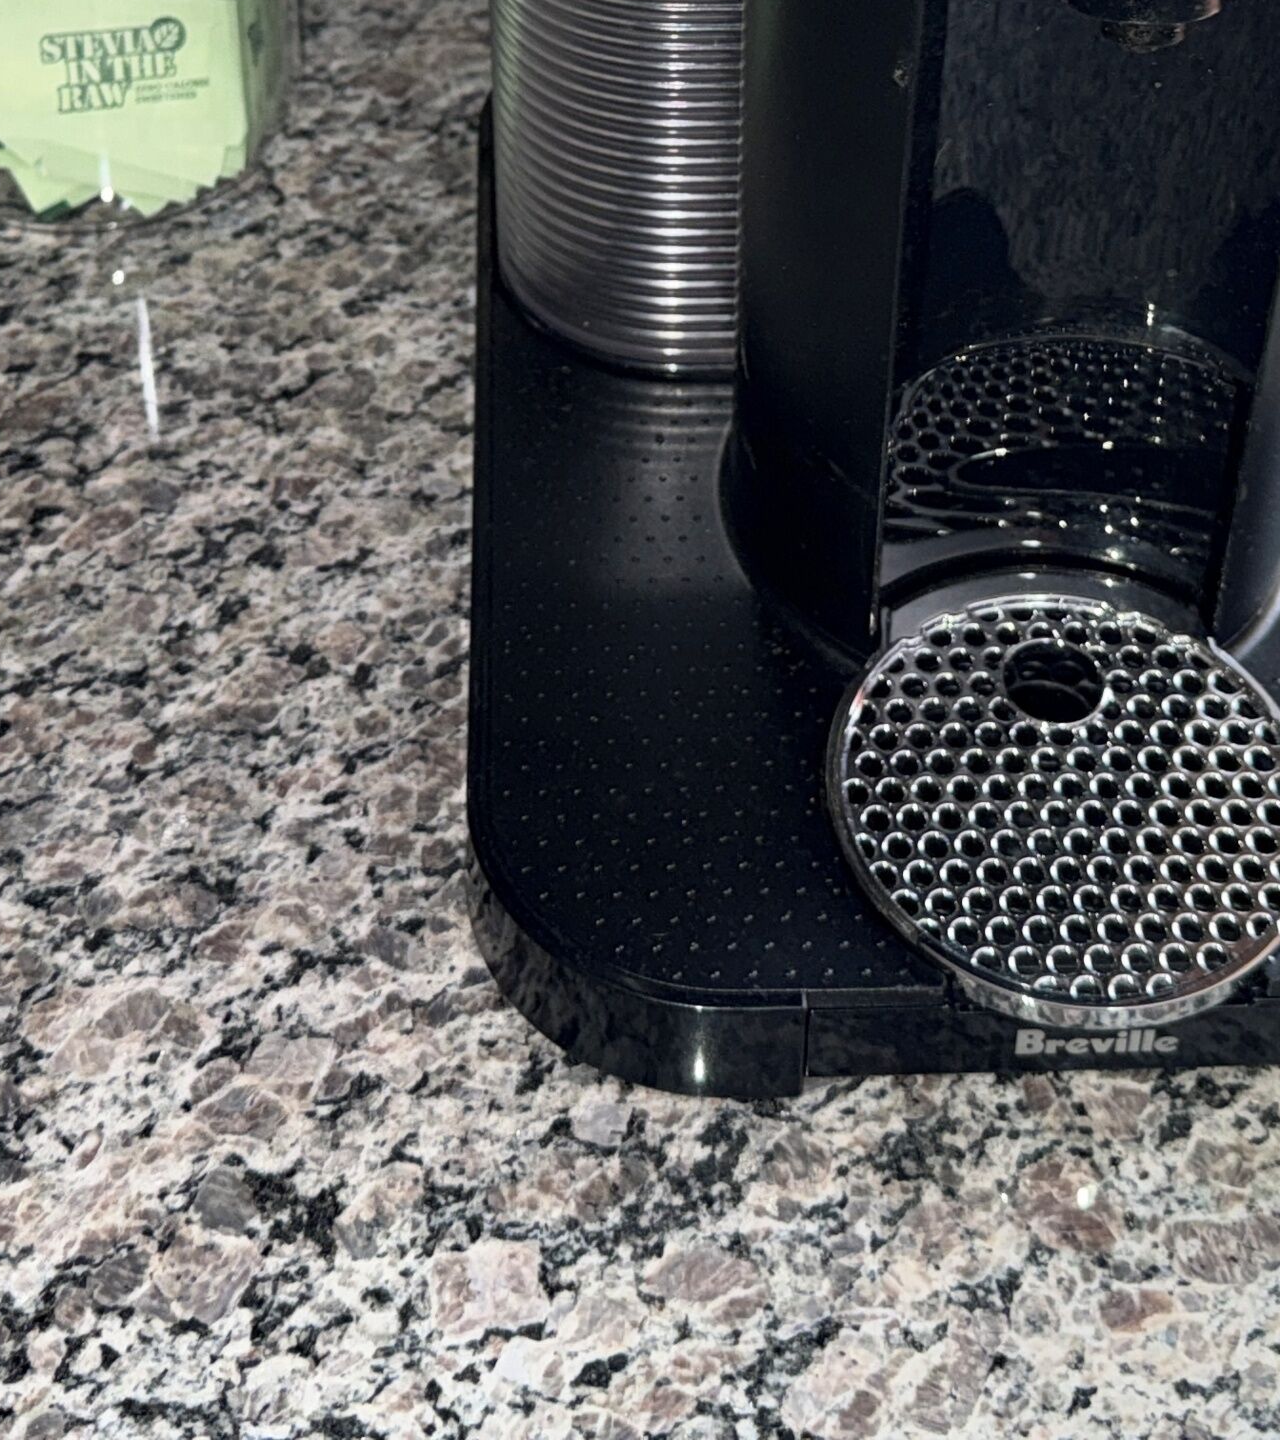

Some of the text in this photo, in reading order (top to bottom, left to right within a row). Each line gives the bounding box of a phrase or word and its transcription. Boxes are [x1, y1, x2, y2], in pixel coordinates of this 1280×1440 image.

[41, 29, 157, 64] STEVIA
[69, 52, 176, 85] IN THE
[59, 82, 131, 114] RAW
[1015, 1028, 1179, 1055] Breville
